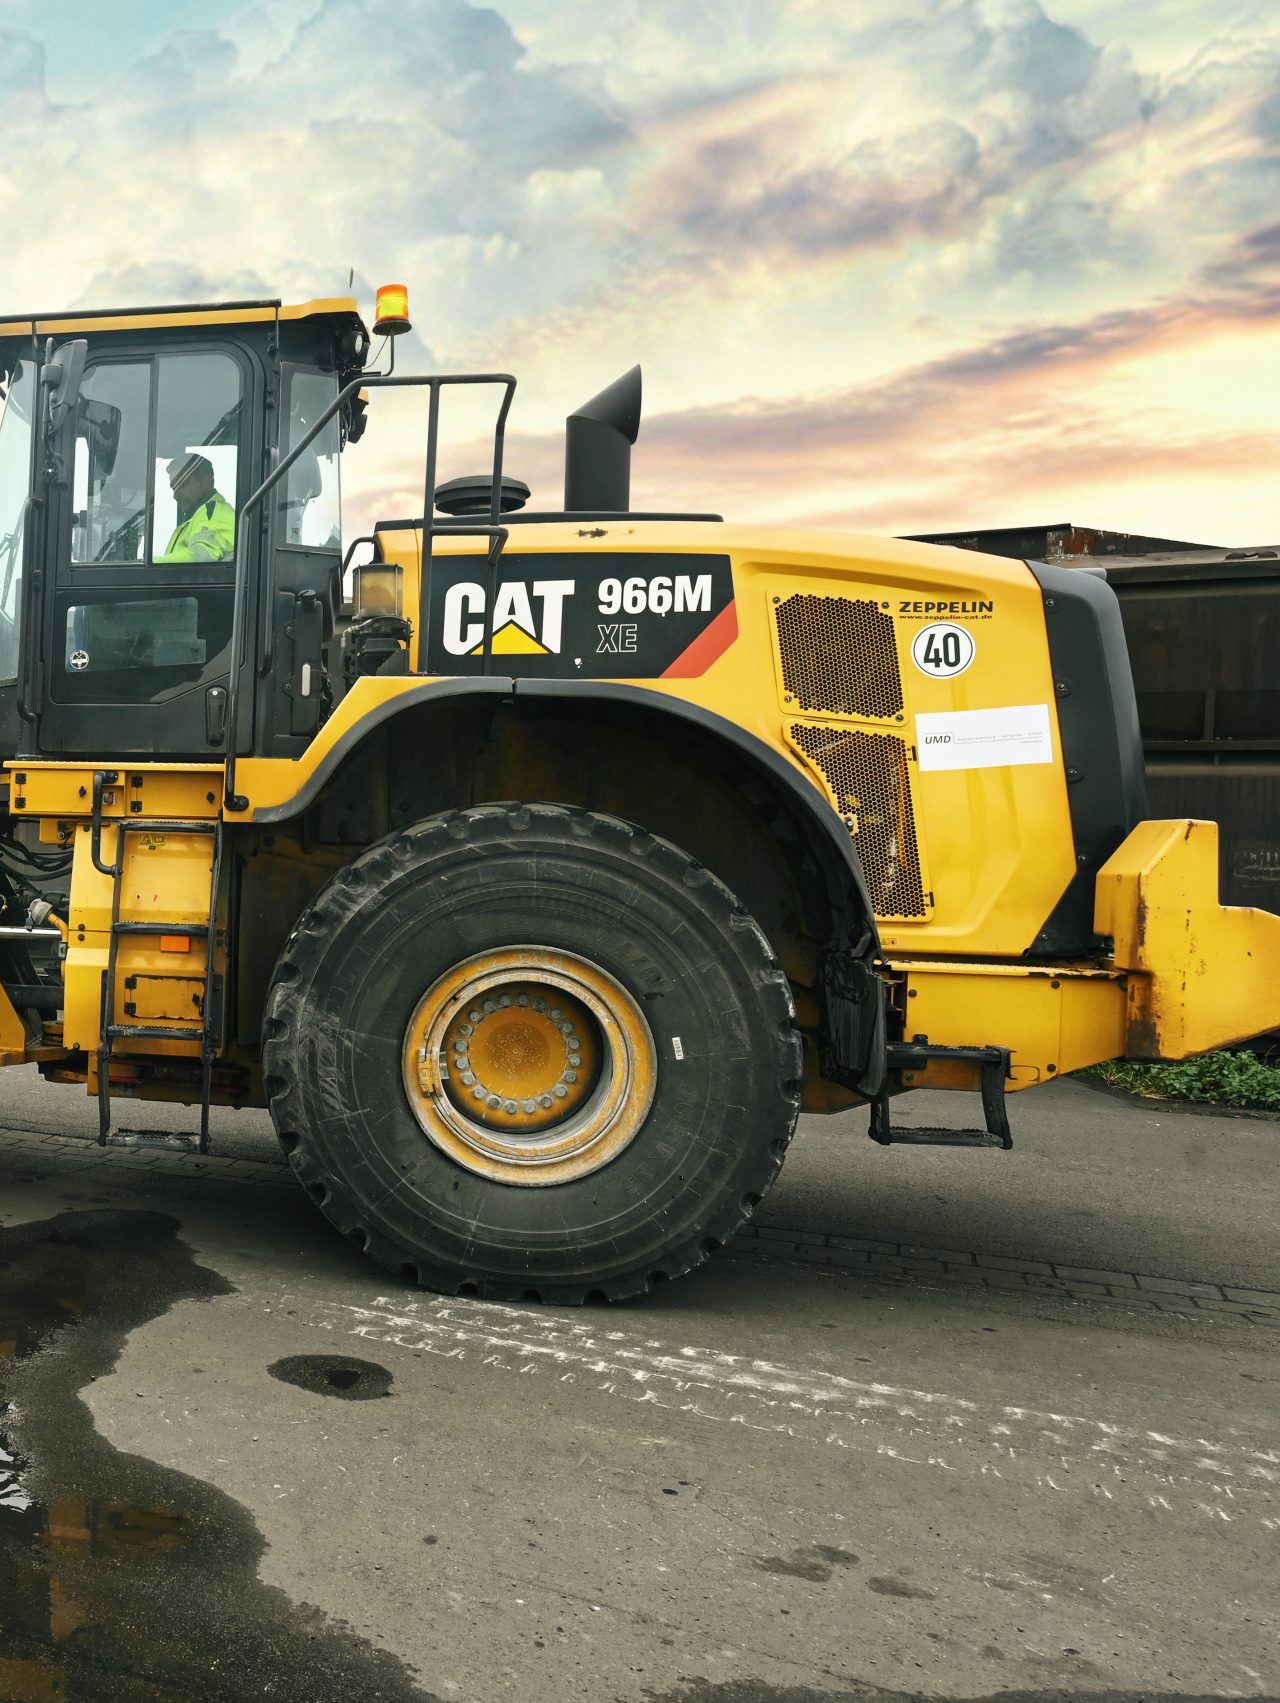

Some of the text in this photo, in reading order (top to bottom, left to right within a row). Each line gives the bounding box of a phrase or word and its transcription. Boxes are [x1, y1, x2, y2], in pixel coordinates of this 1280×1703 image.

[443, 574, 712, 655] CAT 966M
[899, 601, 993, 613] ZEPPELIN
[596, 624, 637, 653] XE
[923, 632, 961, 668] 40
[925, 735, 951, 745] UMD
